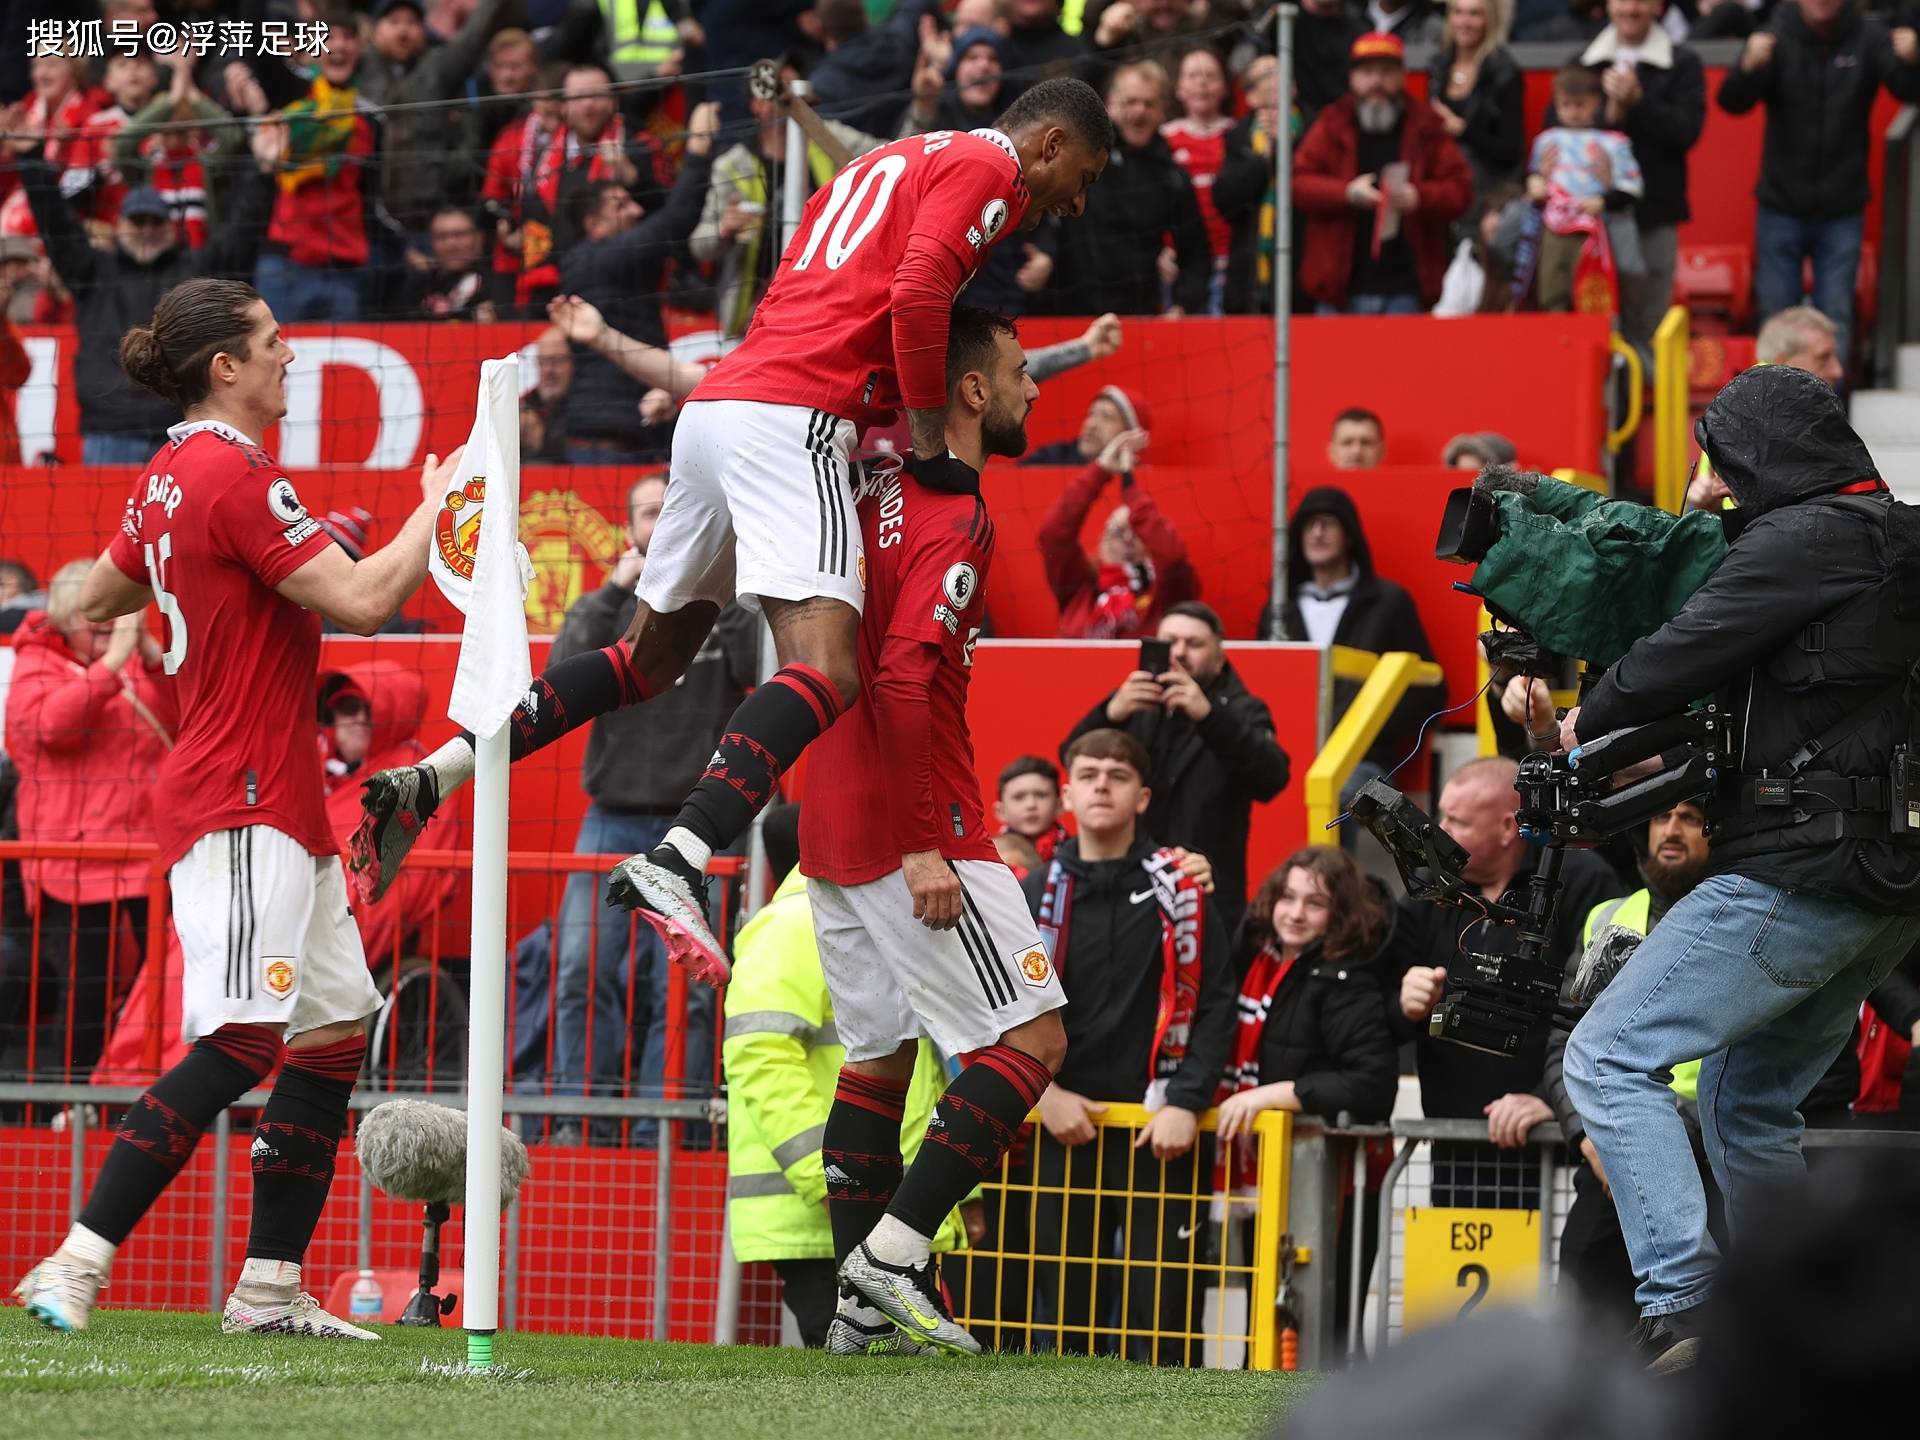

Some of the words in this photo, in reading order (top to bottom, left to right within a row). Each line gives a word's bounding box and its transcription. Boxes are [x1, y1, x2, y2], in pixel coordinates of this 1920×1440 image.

[792, 154, 908, 271] 10
[440, 530, 473, 574] UNITE
[1451, 1222, 1493, 1251] ESP
[1457, 1263, 1491, 1325] 2
